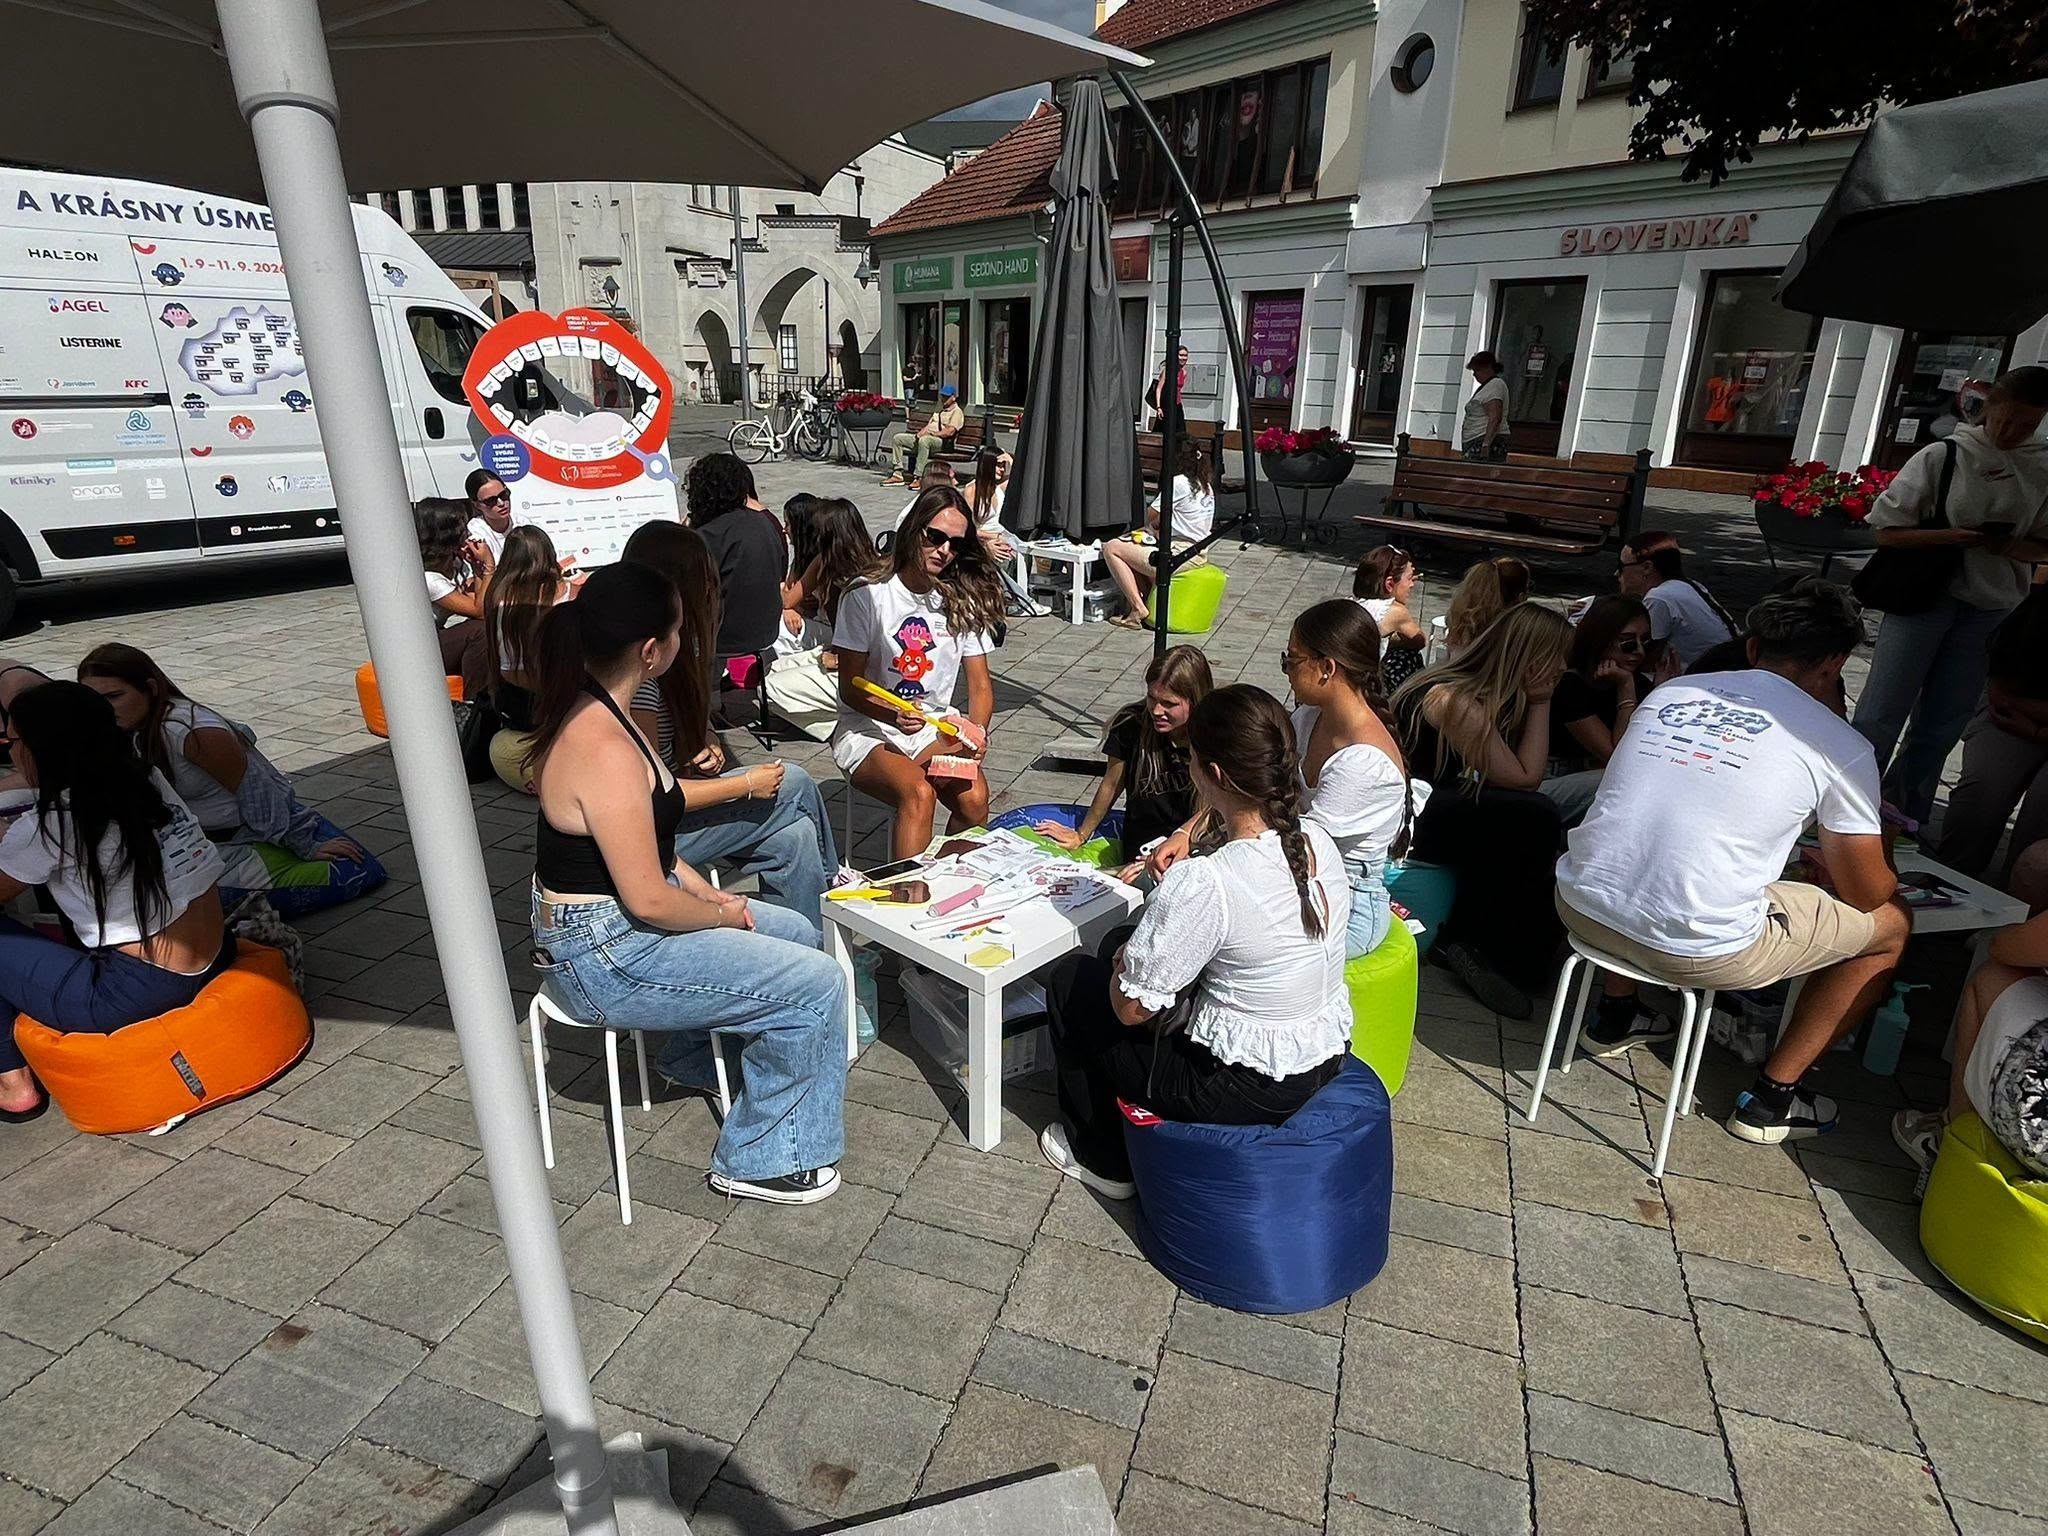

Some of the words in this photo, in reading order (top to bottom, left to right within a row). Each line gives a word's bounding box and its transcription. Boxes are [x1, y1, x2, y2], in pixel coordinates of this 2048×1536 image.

[17, 190, 41, 212] A
[49, 191, 184, 224] KRÁSNY
[1560, 215, 1752, 255] SLOVENKA
[913, 265, 940, 279] HUMANA
[970, 261, 1003, 278] SECOND
[1004, 258, 1029, 275] HAND
[62, 299, 109, 313] AGEL
[60, 337, 122, 348] LISTERINE
[124, 379, 149, 389] KFC
